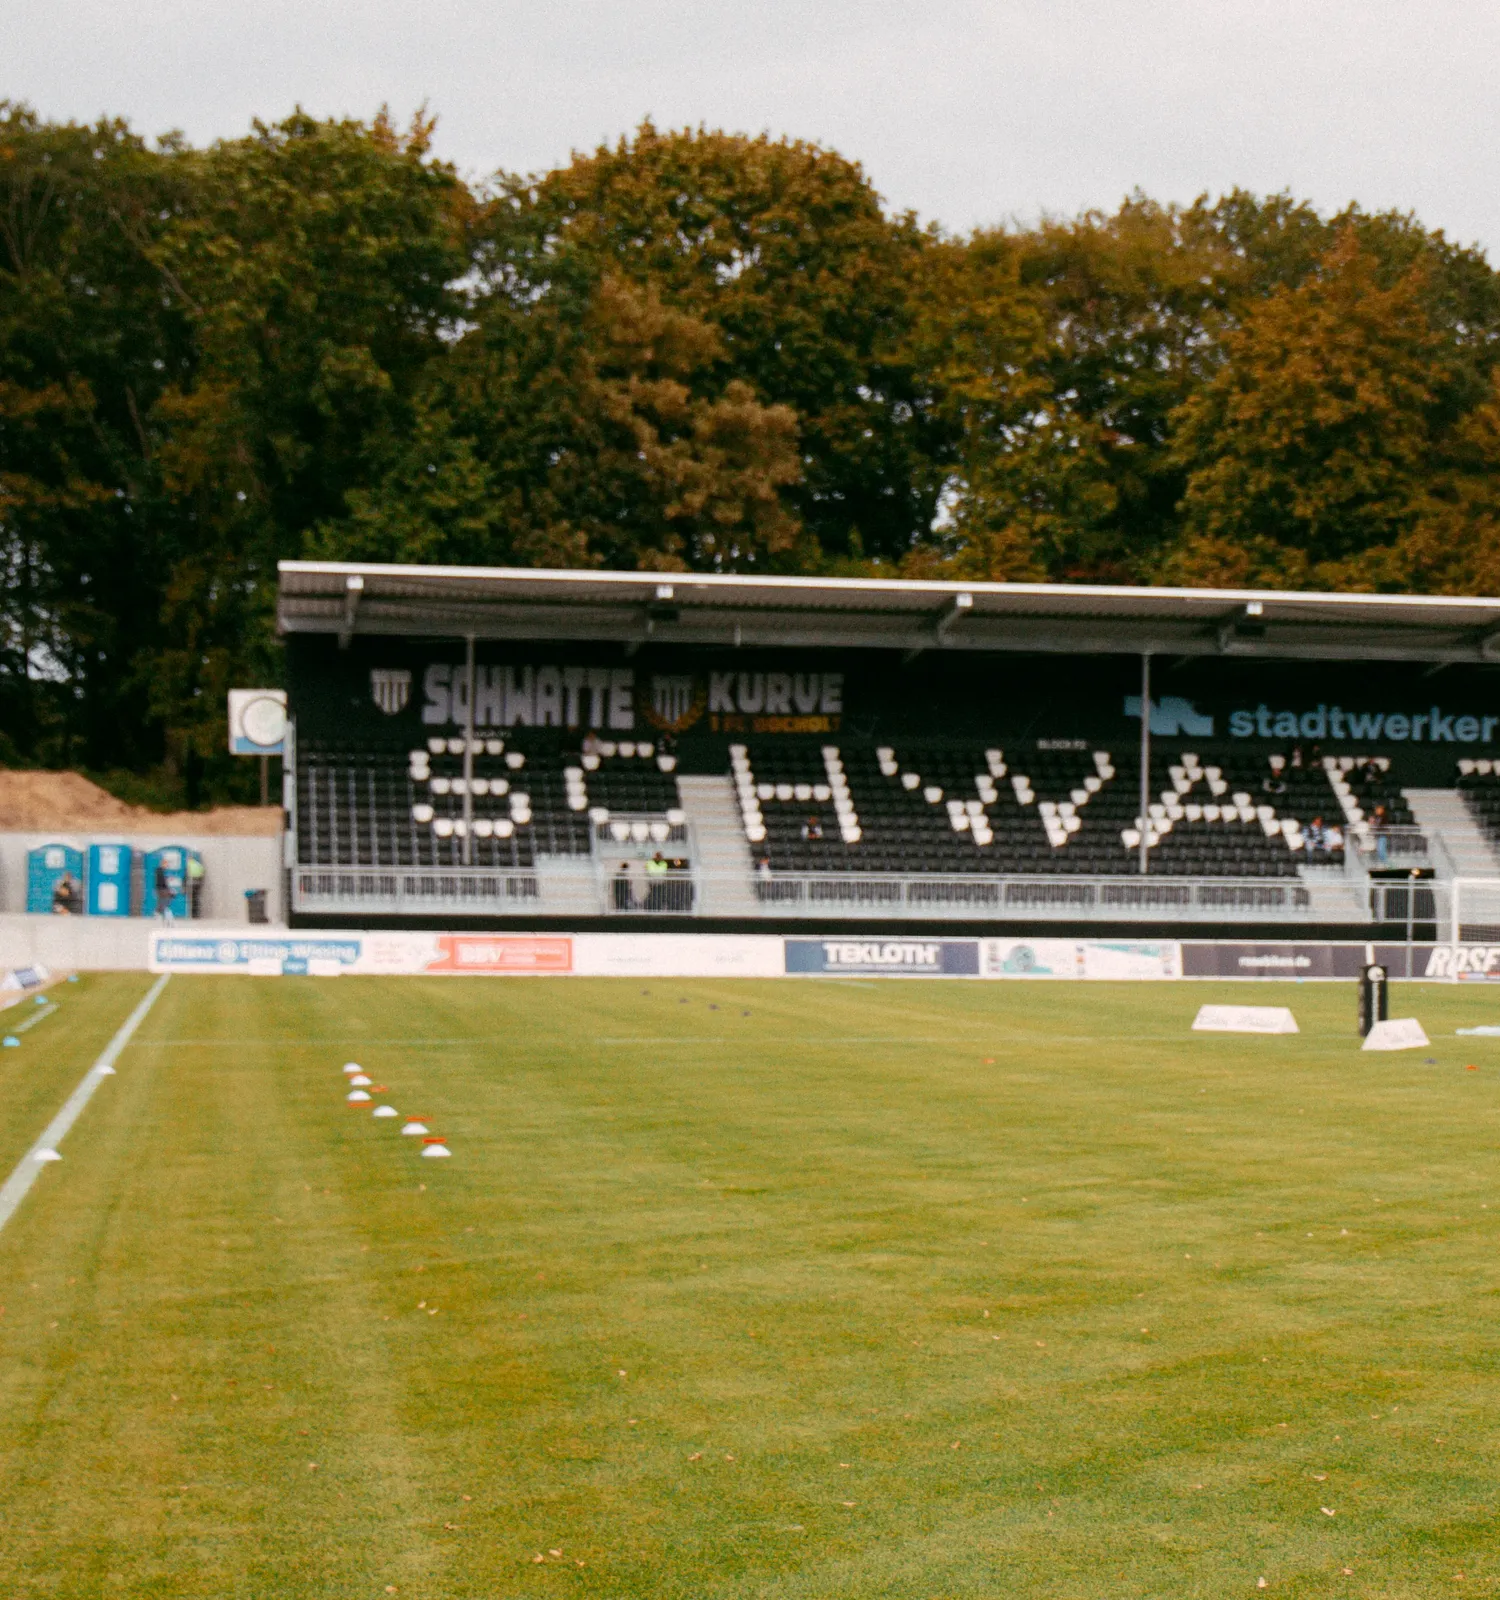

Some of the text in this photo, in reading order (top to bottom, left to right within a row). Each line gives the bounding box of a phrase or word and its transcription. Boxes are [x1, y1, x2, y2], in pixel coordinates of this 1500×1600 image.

[422, 663, 845, 730] SCHWATTE KURVE
[1229, 703, 1499, 742] stadtwerker
